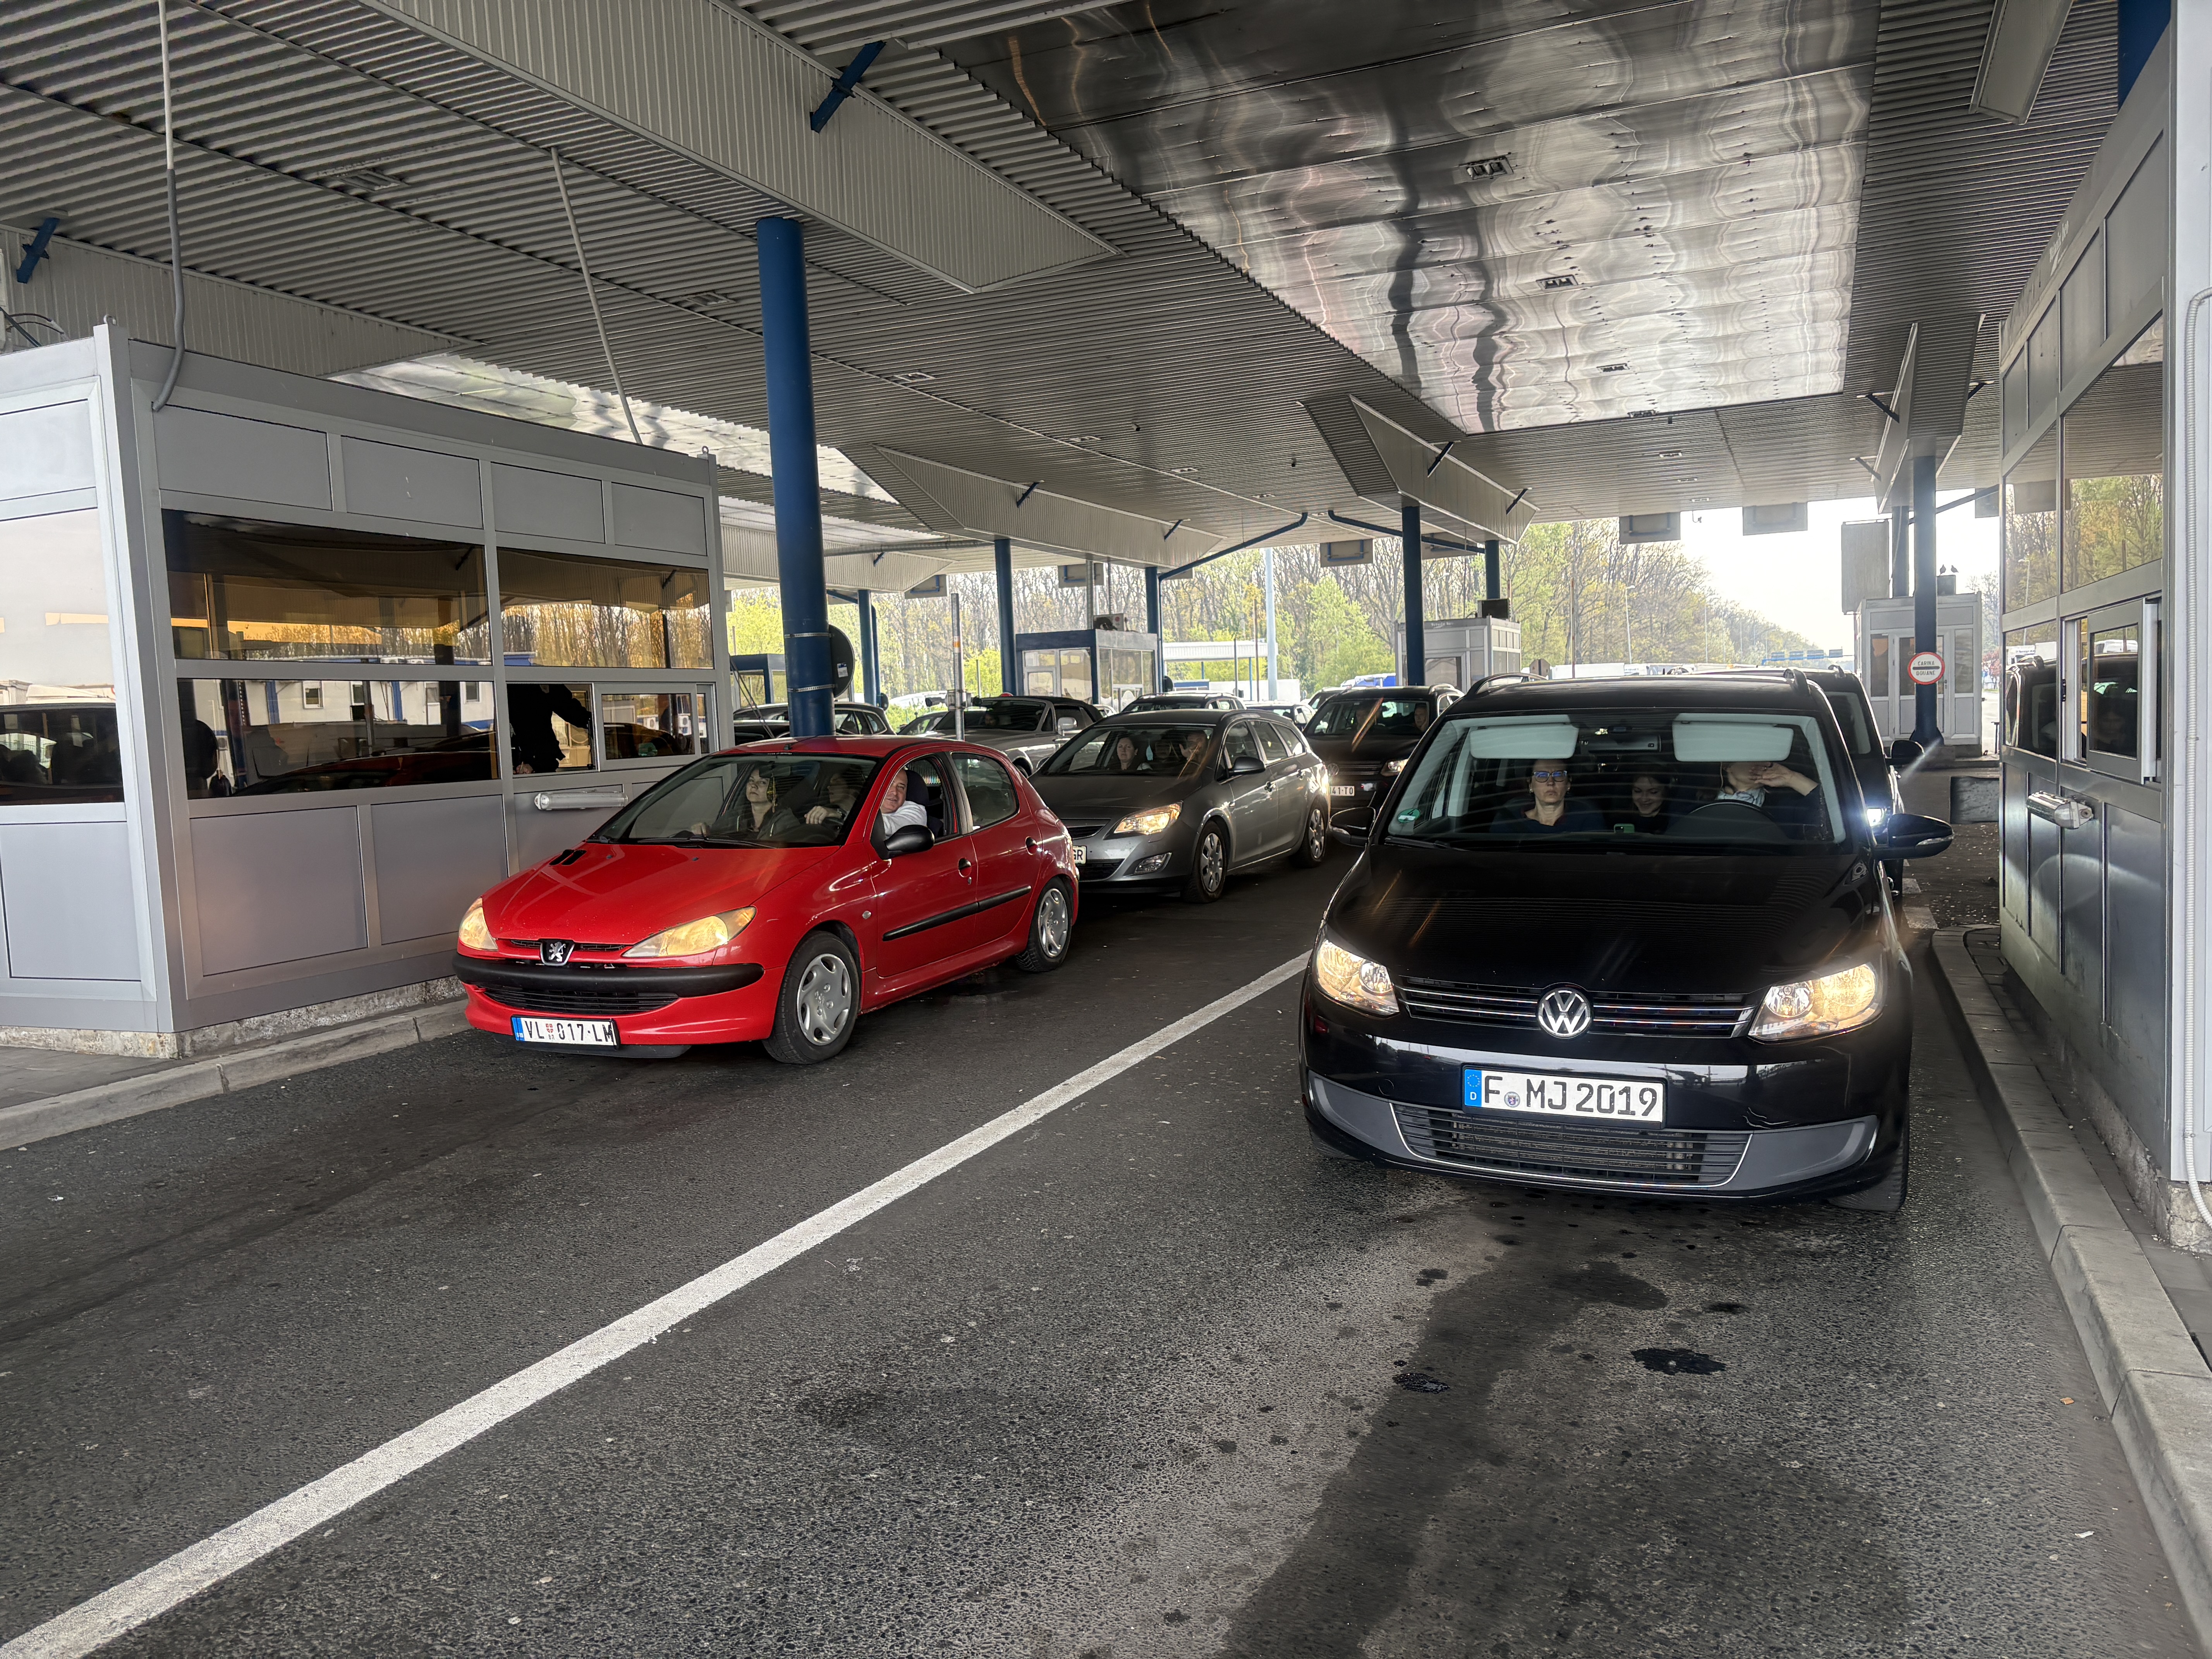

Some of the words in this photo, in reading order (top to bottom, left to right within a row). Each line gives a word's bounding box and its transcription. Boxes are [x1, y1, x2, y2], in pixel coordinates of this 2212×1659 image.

[1544, 990, 1587, 1034] VW
[524, 1020, 544, 1039] VL
[1470, 1092, 1477, 1100] D
[1485, 1075, 1503, 1103] F
